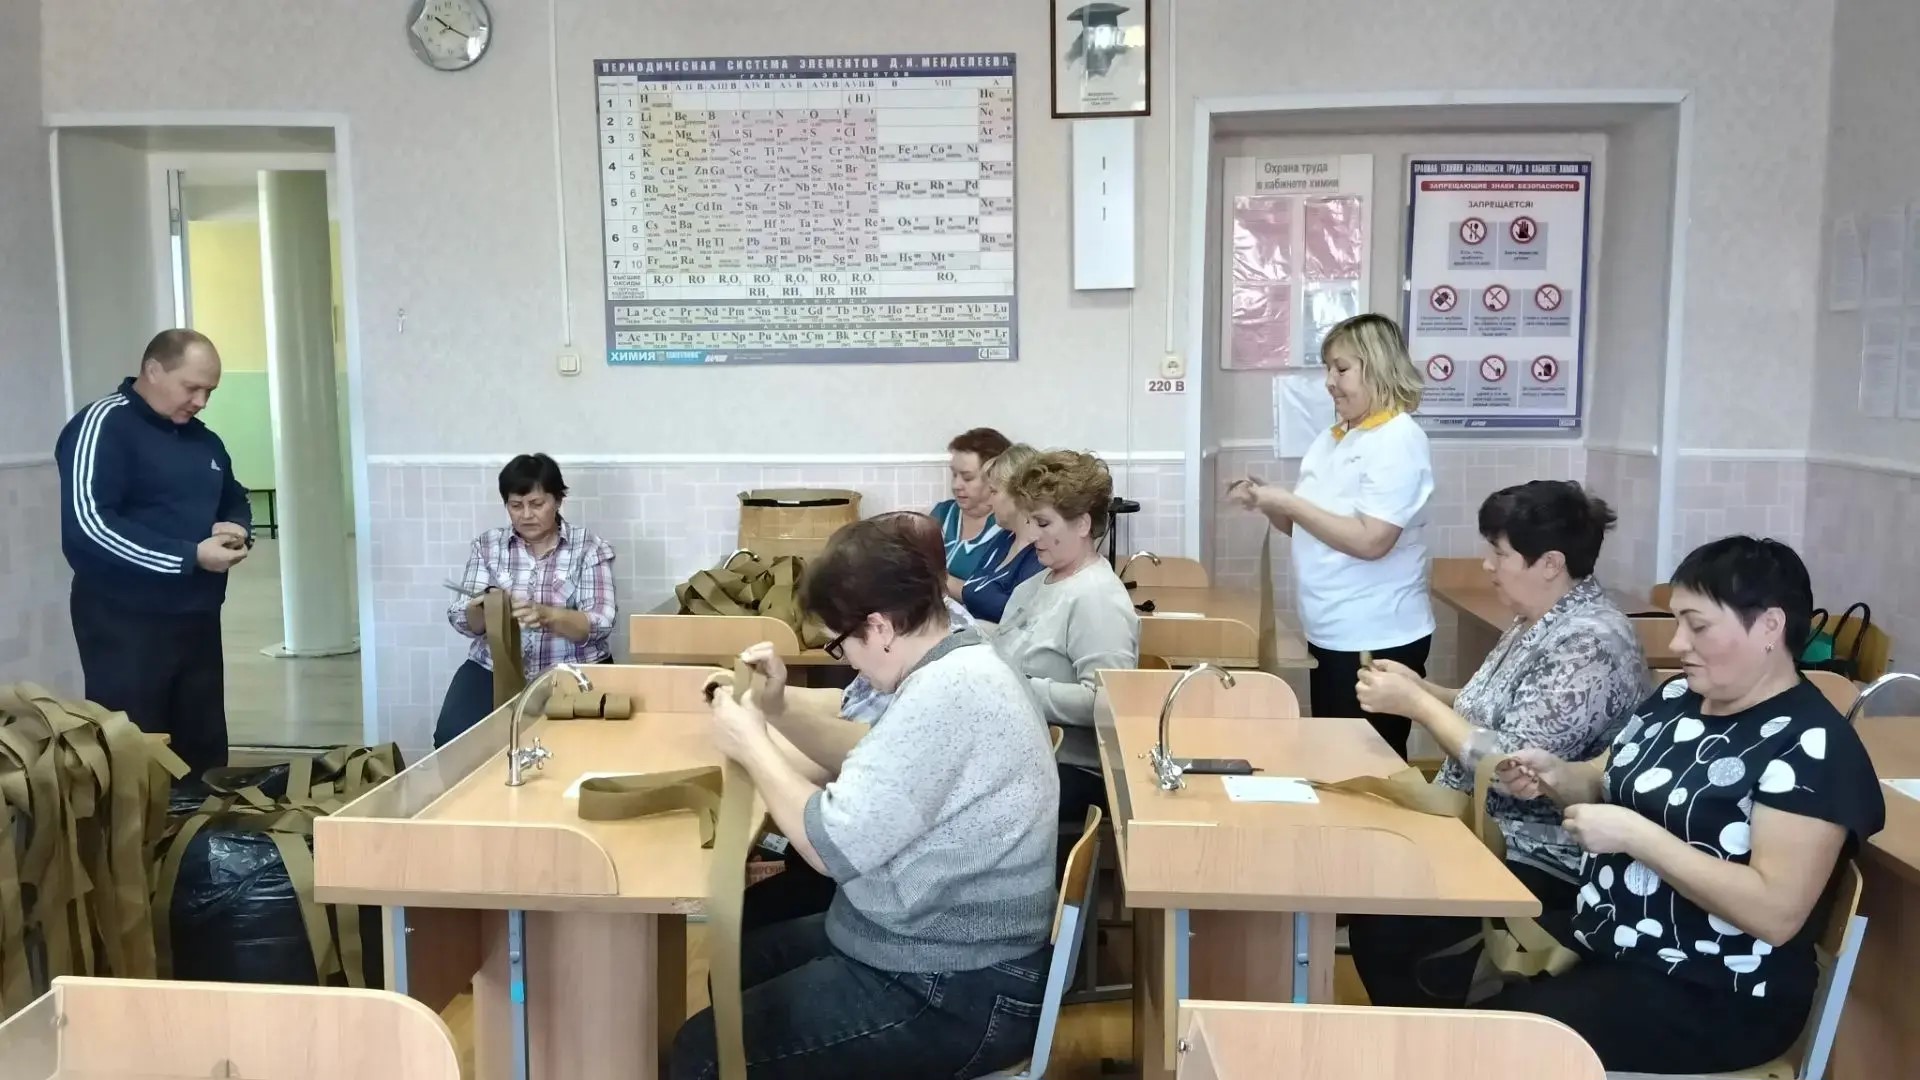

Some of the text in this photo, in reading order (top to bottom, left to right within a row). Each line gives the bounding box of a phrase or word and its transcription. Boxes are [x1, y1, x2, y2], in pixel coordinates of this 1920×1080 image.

[603, 60, 716, 73] ПЕРИОДИЧЕСКАЯ
[728, 59, 788, 71] СИСТЕМА
[800, 58, 878, 69] ЭЛЕМЕНТОВ
[1264, 162, 1328, 175] Охрана труда
[1310, 180, 1338, 188] химии
[1468, 200, 1534, 208] ЗАПРЕЩАЕТСЯ!
[611, 352, 656, 362] ХИМИЯ
[1148, 380, 1172, 392] 220
